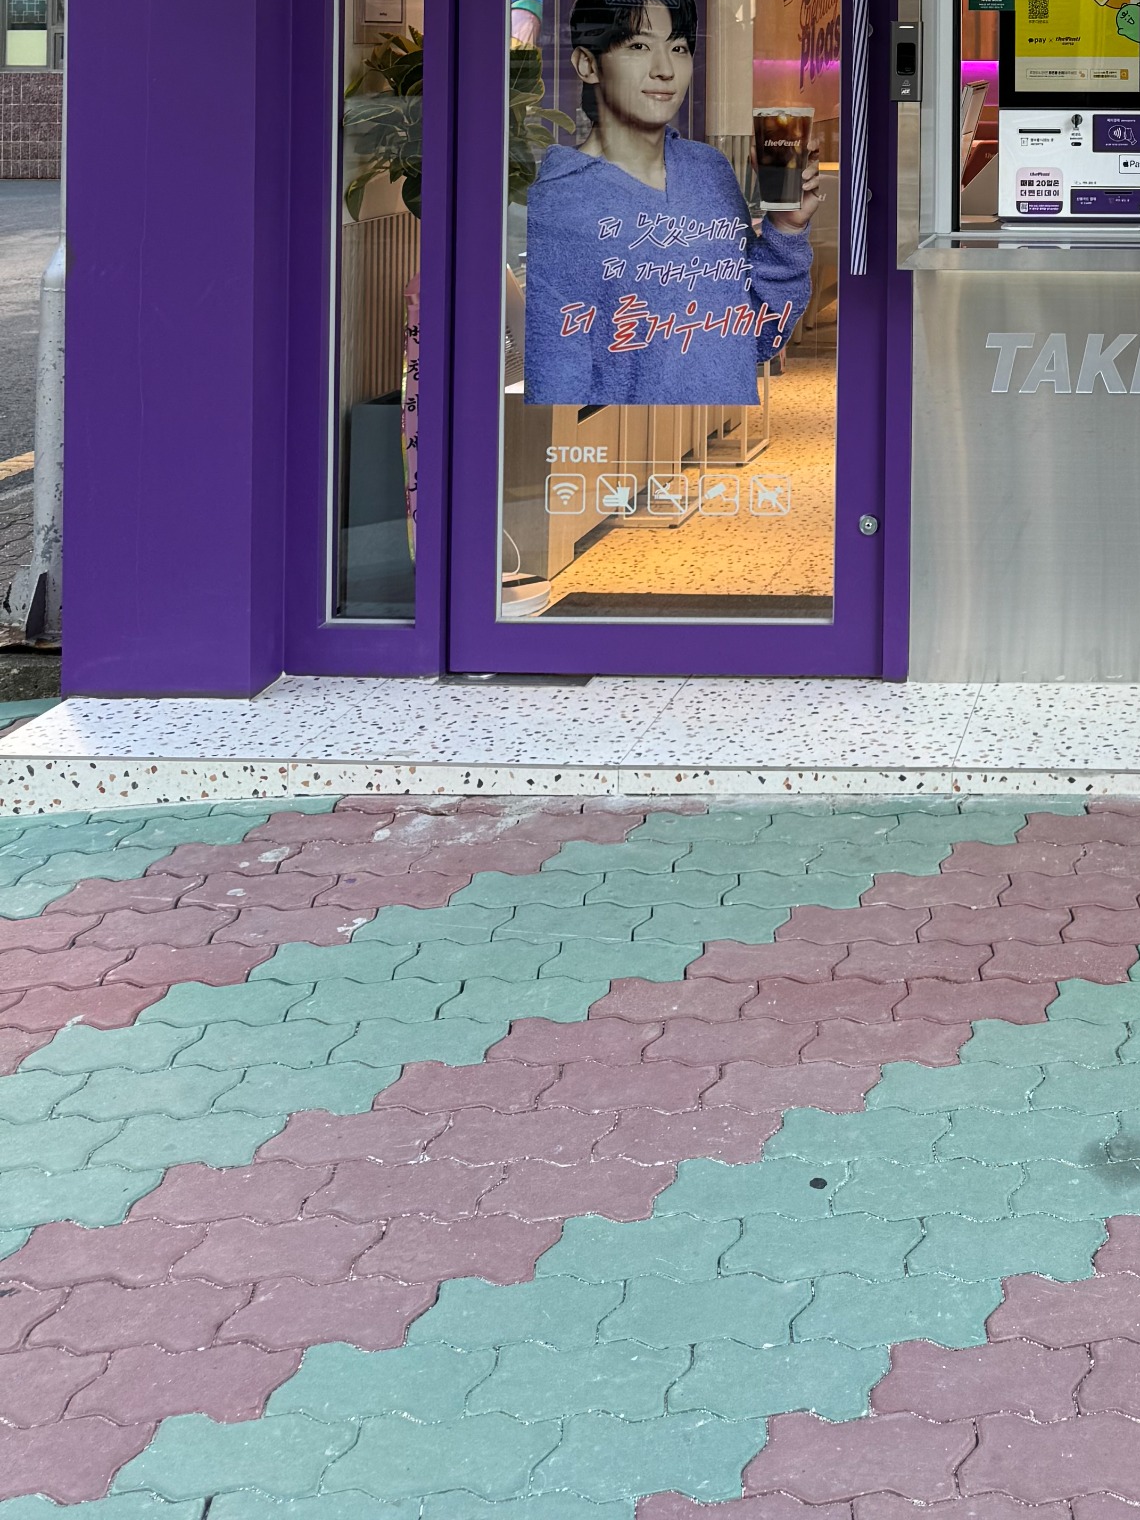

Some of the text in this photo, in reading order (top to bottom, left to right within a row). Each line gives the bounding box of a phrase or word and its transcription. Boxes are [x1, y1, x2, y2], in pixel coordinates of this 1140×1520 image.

[598, 217, 622, 238] 더
[602, 257, 624, 280] 더
[560, 293, 793, 355] 더 즐거우니까!
[545, 446, 609, 464] STORE
